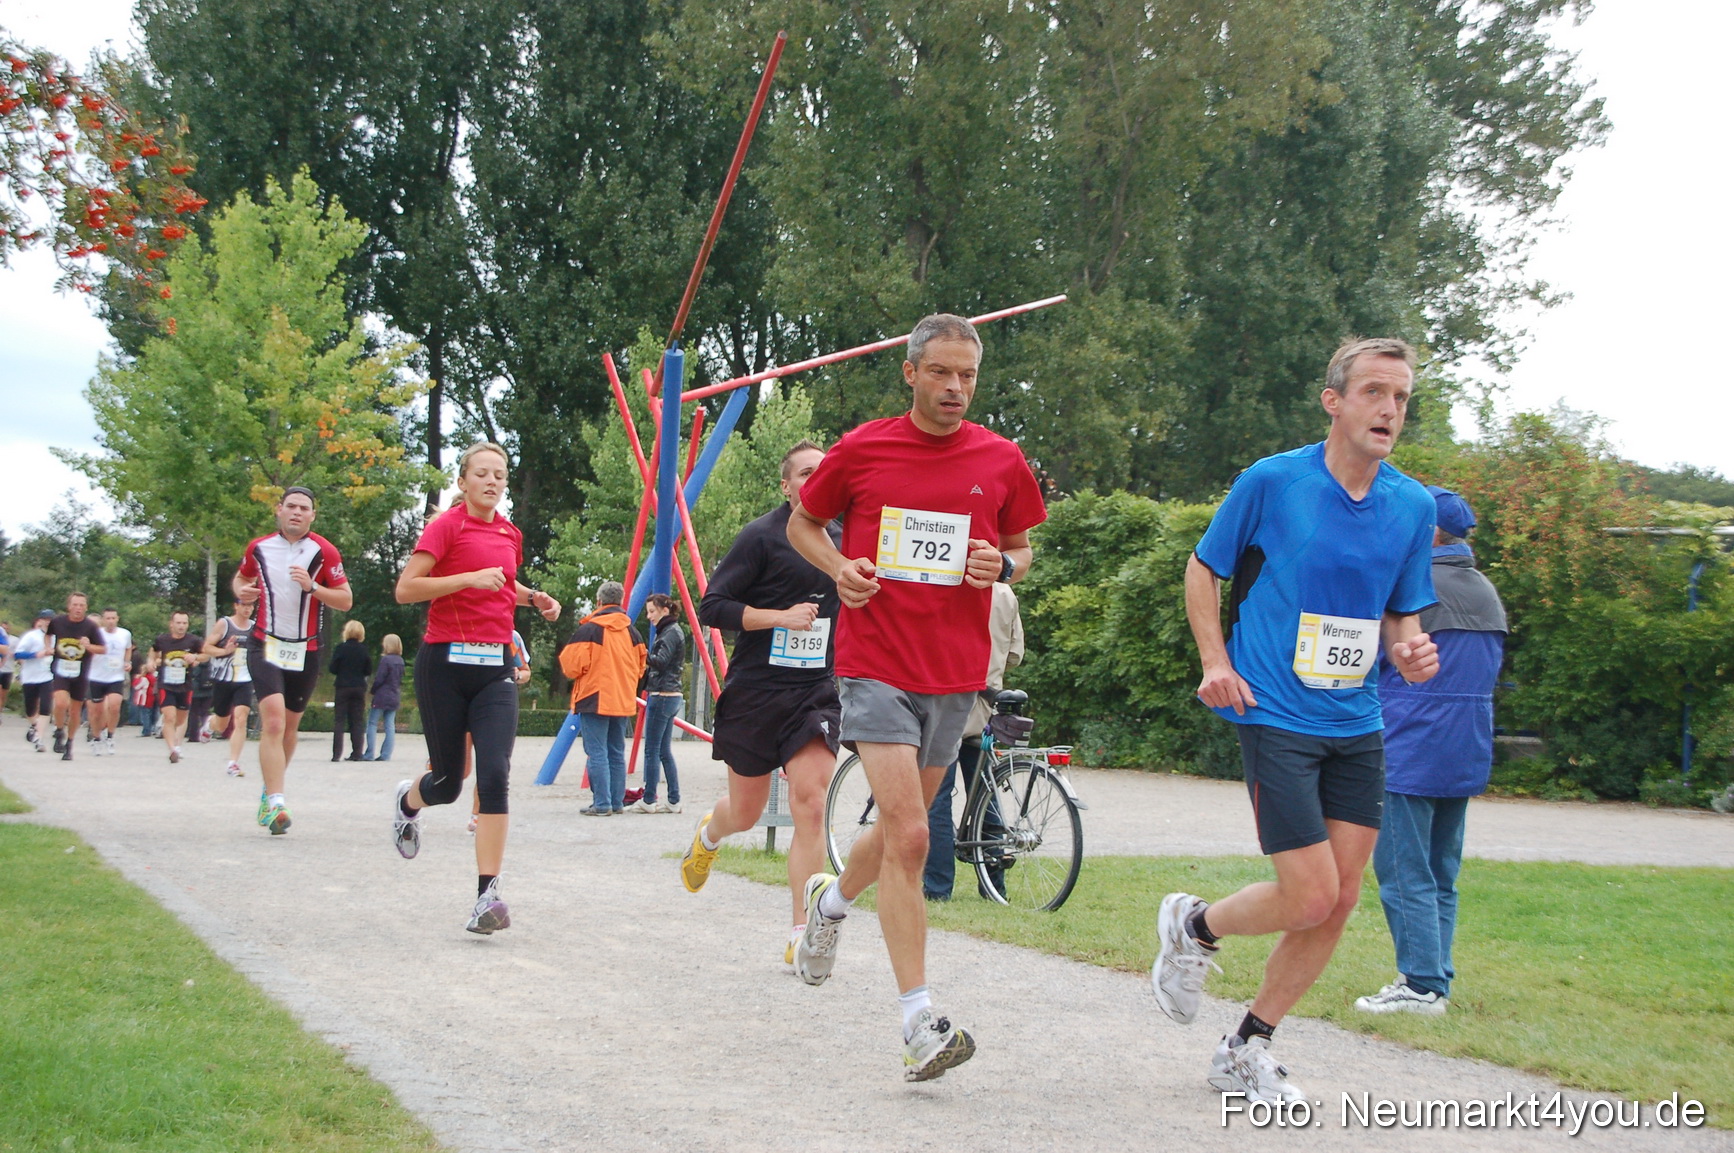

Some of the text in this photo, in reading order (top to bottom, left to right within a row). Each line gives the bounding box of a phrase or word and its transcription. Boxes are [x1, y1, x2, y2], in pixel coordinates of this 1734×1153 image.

[905, 516, 955, 534] Christian
[882, 535, 889, 545] B
[911, 540, 951, 562] 792
[1322, 622, 1362, 639] Werner
[790, 637, 822, 650] 3159
[1299, 641, 1306, 652] B
[279, 649, 298, 660] 975
[1326, 646, 1363, 667] 582
